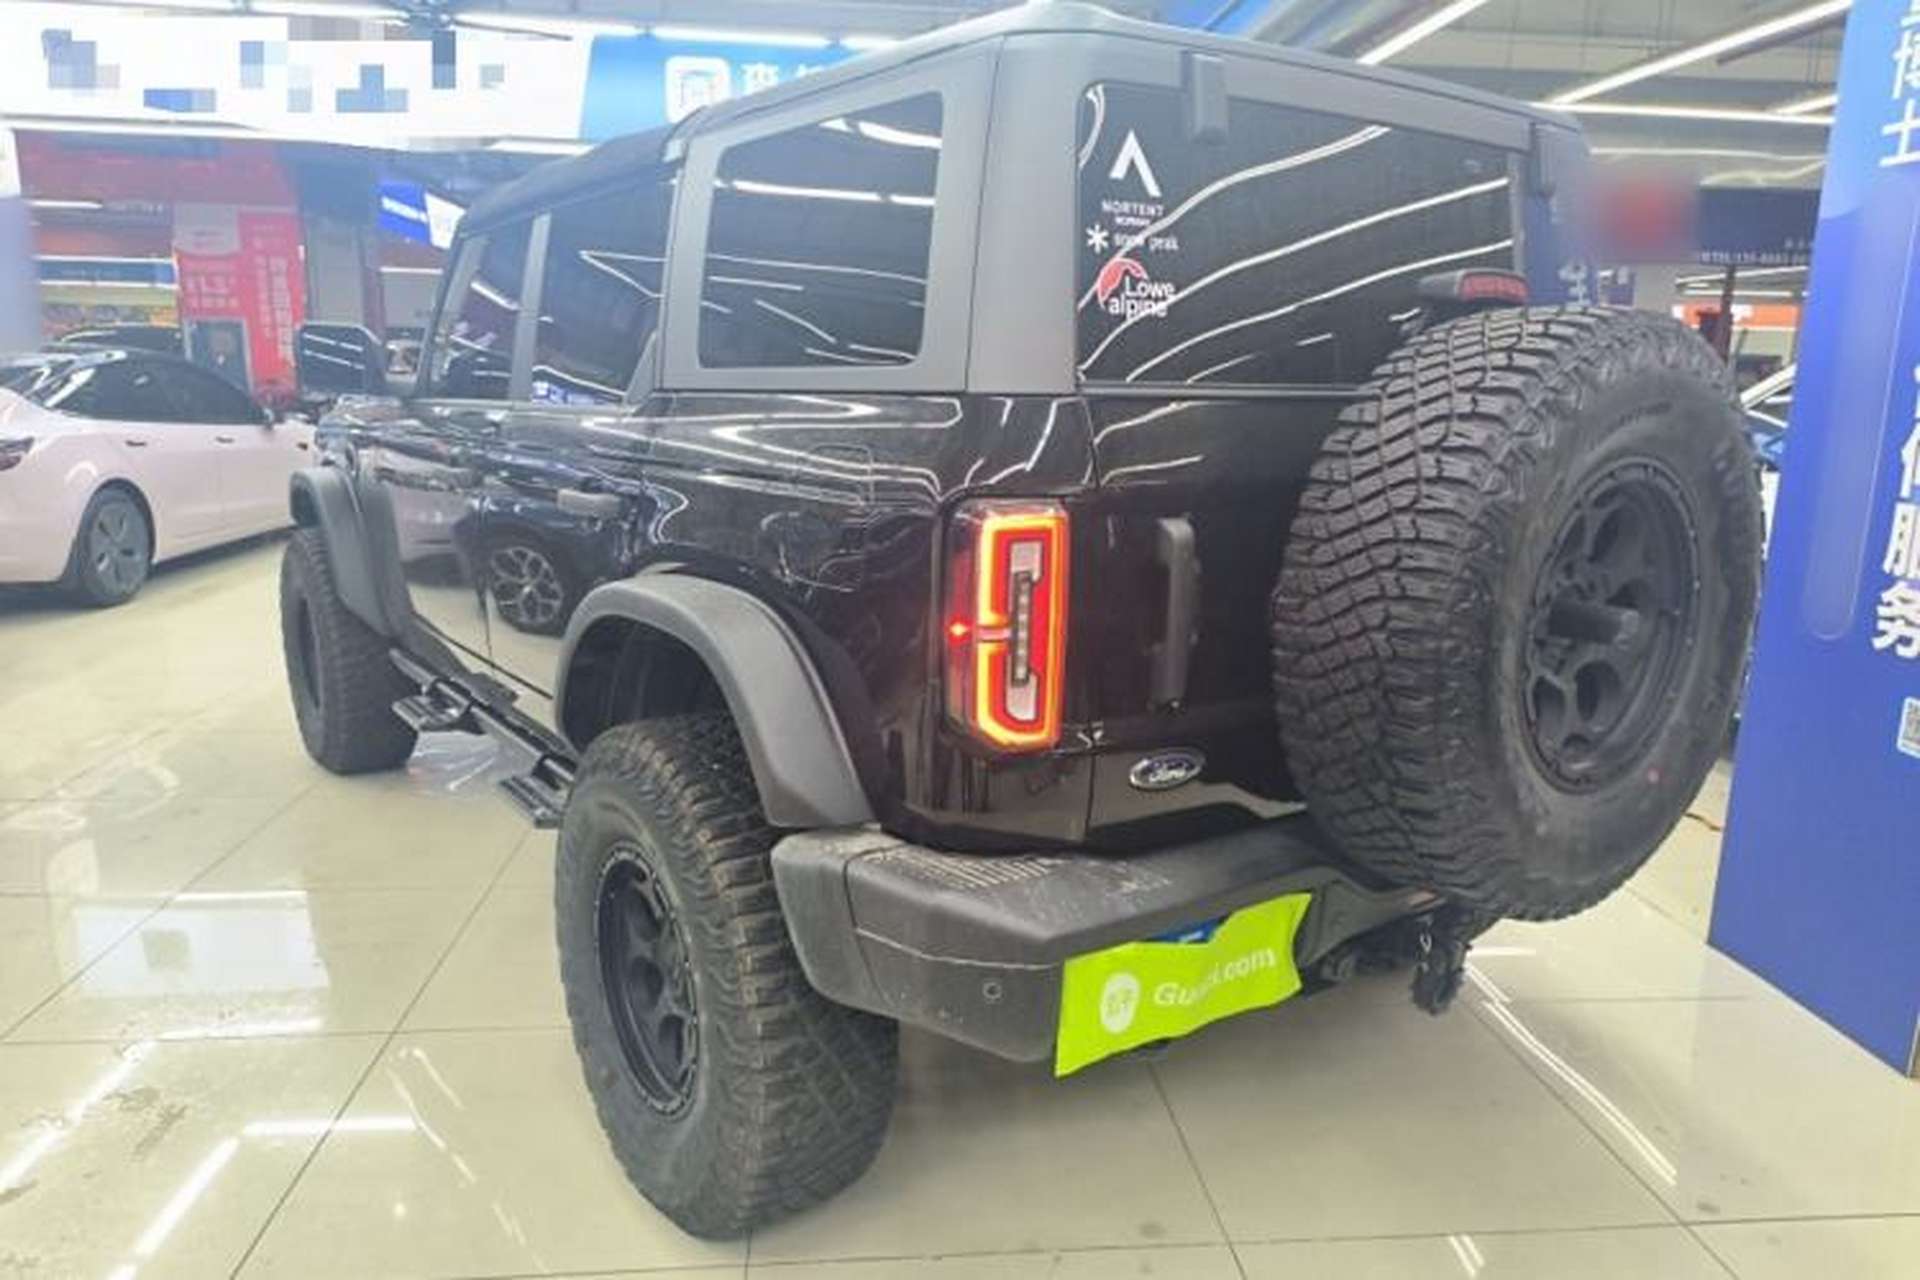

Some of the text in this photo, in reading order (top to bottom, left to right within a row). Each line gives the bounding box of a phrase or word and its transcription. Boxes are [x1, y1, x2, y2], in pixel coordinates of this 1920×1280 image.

[1101, 200, 1165, 217] NORTENT
[1125, 275, 1175, 298] Lowe
[1108, 294, 1168, 321] alpine
